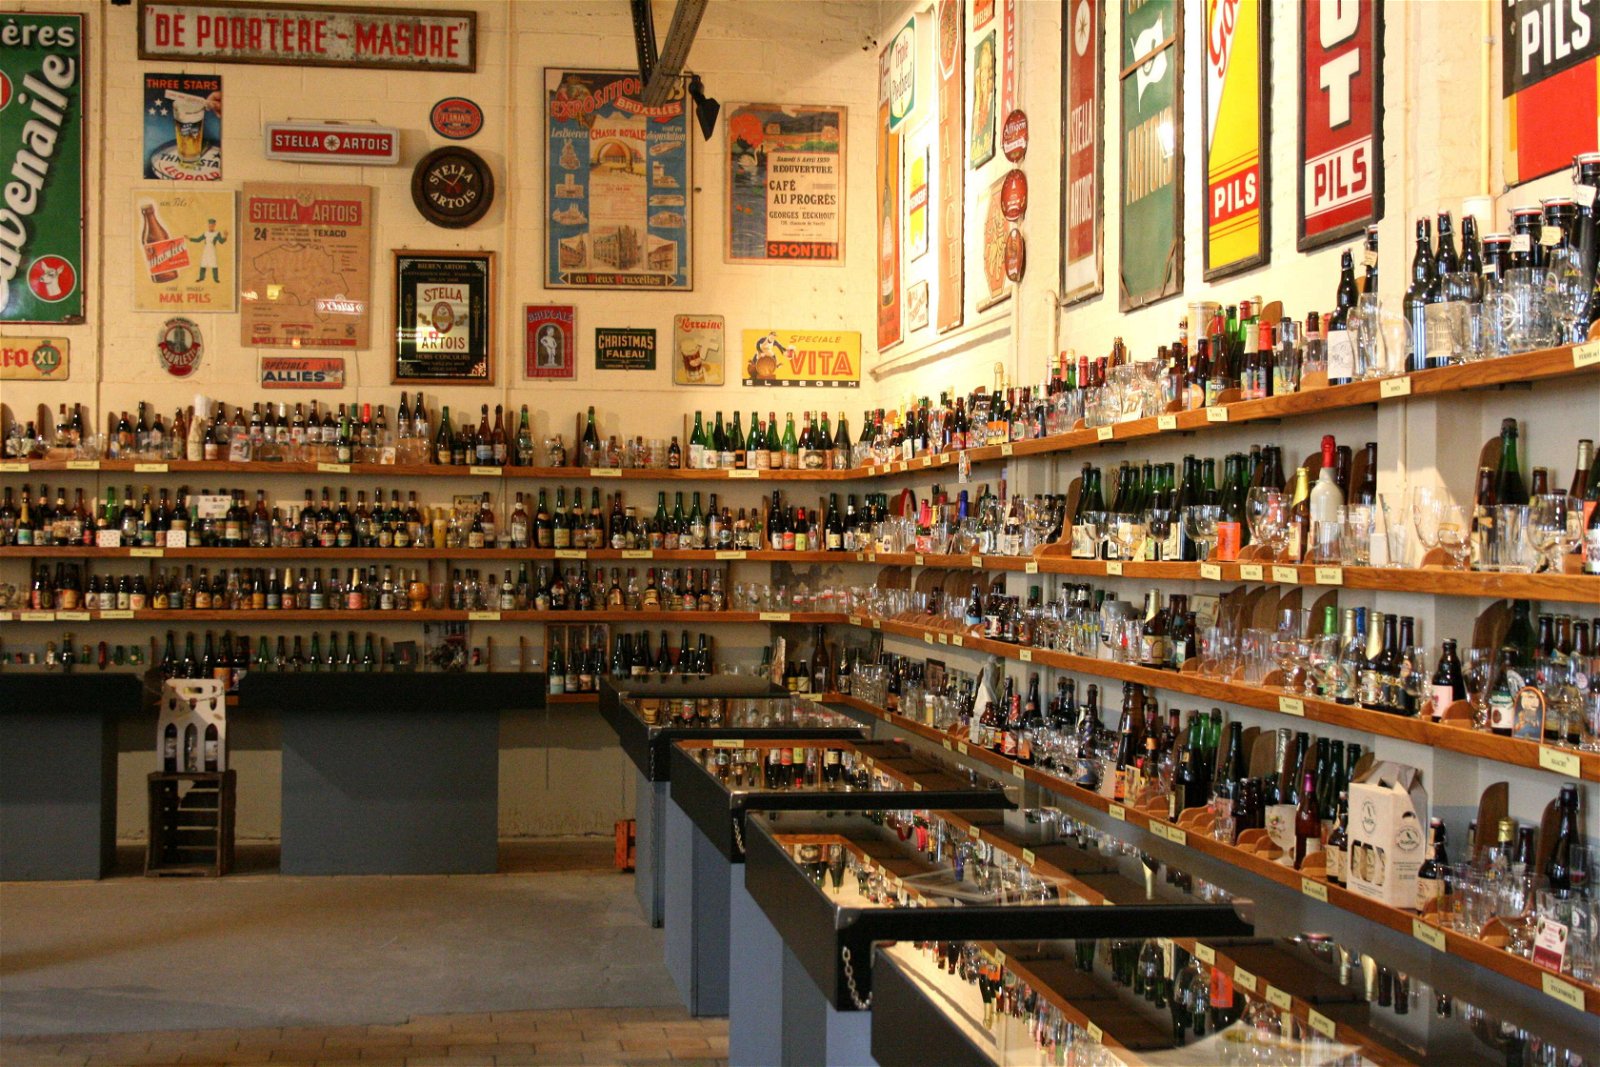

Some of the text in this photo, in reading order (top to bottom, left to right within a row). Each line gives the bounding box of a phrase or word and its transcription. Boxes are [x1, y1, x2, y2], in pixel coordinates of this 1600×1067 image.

[197, 15, 327, 53] POORTERE
[1521, 0, 1592, 76] PILS
[146, 78, 218, 90] THREE STARS
[1070, 98, 1093, 154] STELLA
[275, 135, 390, 151] STELLA ARTOIS
[619, 128, 647, 142] ROYALE
[1126, 106, 1174, 206] ARTOIS
[429, 164, 474, 185] STELLA
[1313, 147, 1367, 207] PILS
[430, 189, 477, 209] ARTOIS
[773, 194, 788, 205] AU
[1069, 173, 1093, 230] ARTOIS
[1214, 172, 1257, 219] PILS
[253, 202, 359, 223] STELLA ARTOIS
[768, 211, 799, 220] GEORGES
[253, 227, 268, 241] 24
[313, 229, 347, 239] TEXACO
[769, 243, 838, 258] SPONTIN
[159, 293, 212, 304] MAK PILS
[423, 287, 464, 303] STELLA
[677, 316, 723, 333] Lorraine
[421, 337, 466, 350] ARTOIS
[598, 334, 654, 350] CHRISTMAS
[789, 335, 842, 344] SPECIALE
[35, 351, 56, 366] XL
[606, 350, 646, 359] FALEAU
[789, 351, 853, 376] VITA
[745, 380, 857, 388] ELSEGEM
